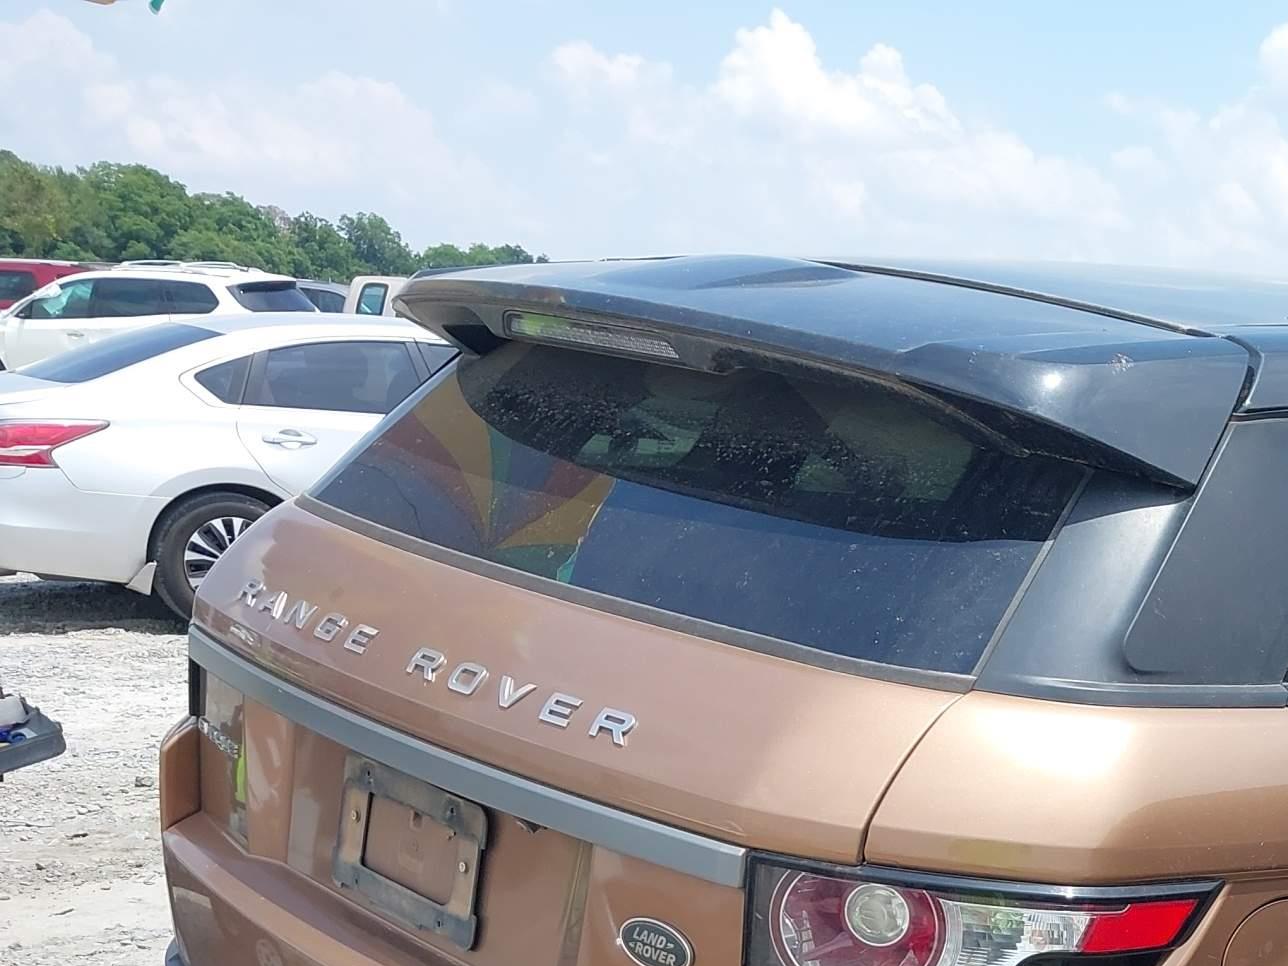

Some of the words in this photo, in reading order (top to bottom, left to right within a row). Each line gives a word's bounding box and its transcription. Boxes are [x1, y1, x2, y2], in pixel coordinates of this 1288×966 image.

[238, 578, 380, 655] RANGE
[405, 646, 639, 747] ROVER
[632, 926, 667, 949] LAND
[634, 941, 677, 966] ROVER
